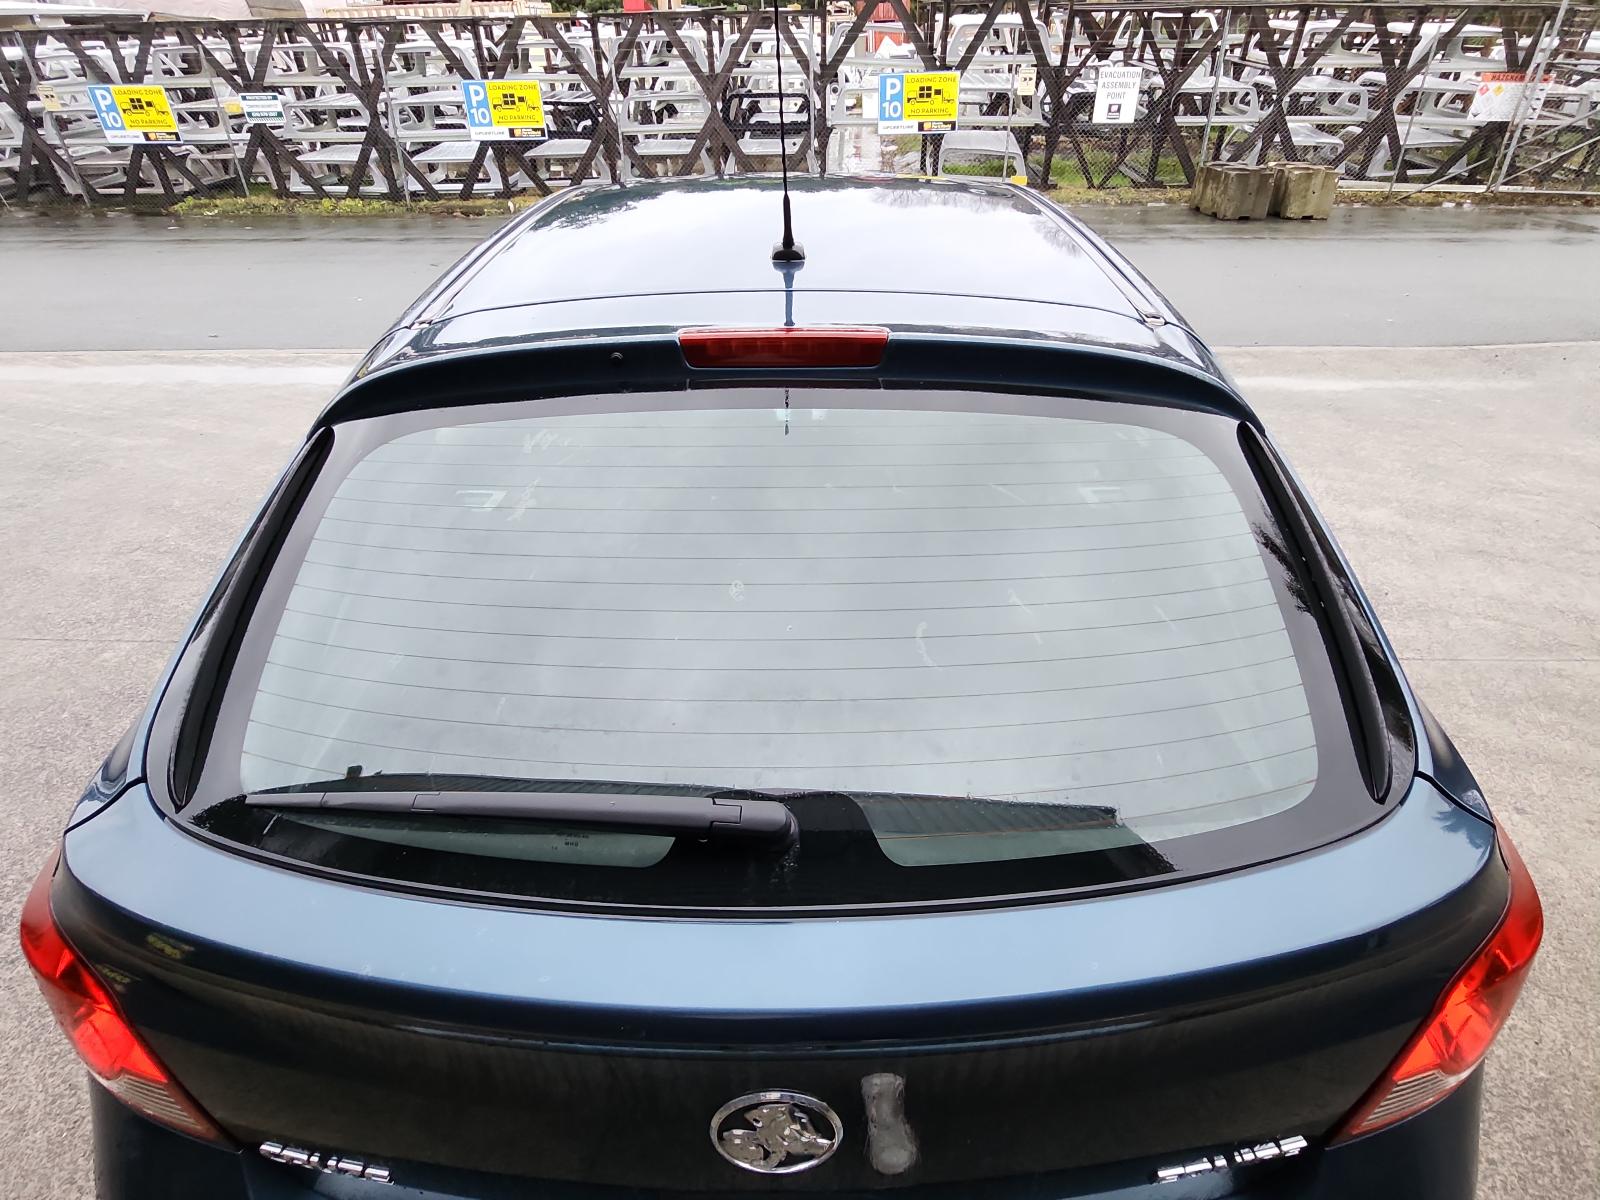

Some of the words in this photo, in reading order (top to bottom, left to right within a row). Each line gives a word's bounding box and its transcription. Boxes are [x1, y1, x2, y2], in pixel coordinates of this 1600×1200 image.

[1100, 71, 1141, 79] EVACUATION
[885, 78, 901, 101] P
[1101, 81, 1137, 89] ASSEMBLY
[94, 89, 112, 111] P
[468, 84, 485, 107] P
[1106, 92, 1126, 100] POINT
[470, 107, 490, 124] 10
[882, 101, 902, 118] 10
[100, 111, 122, 128] 10
